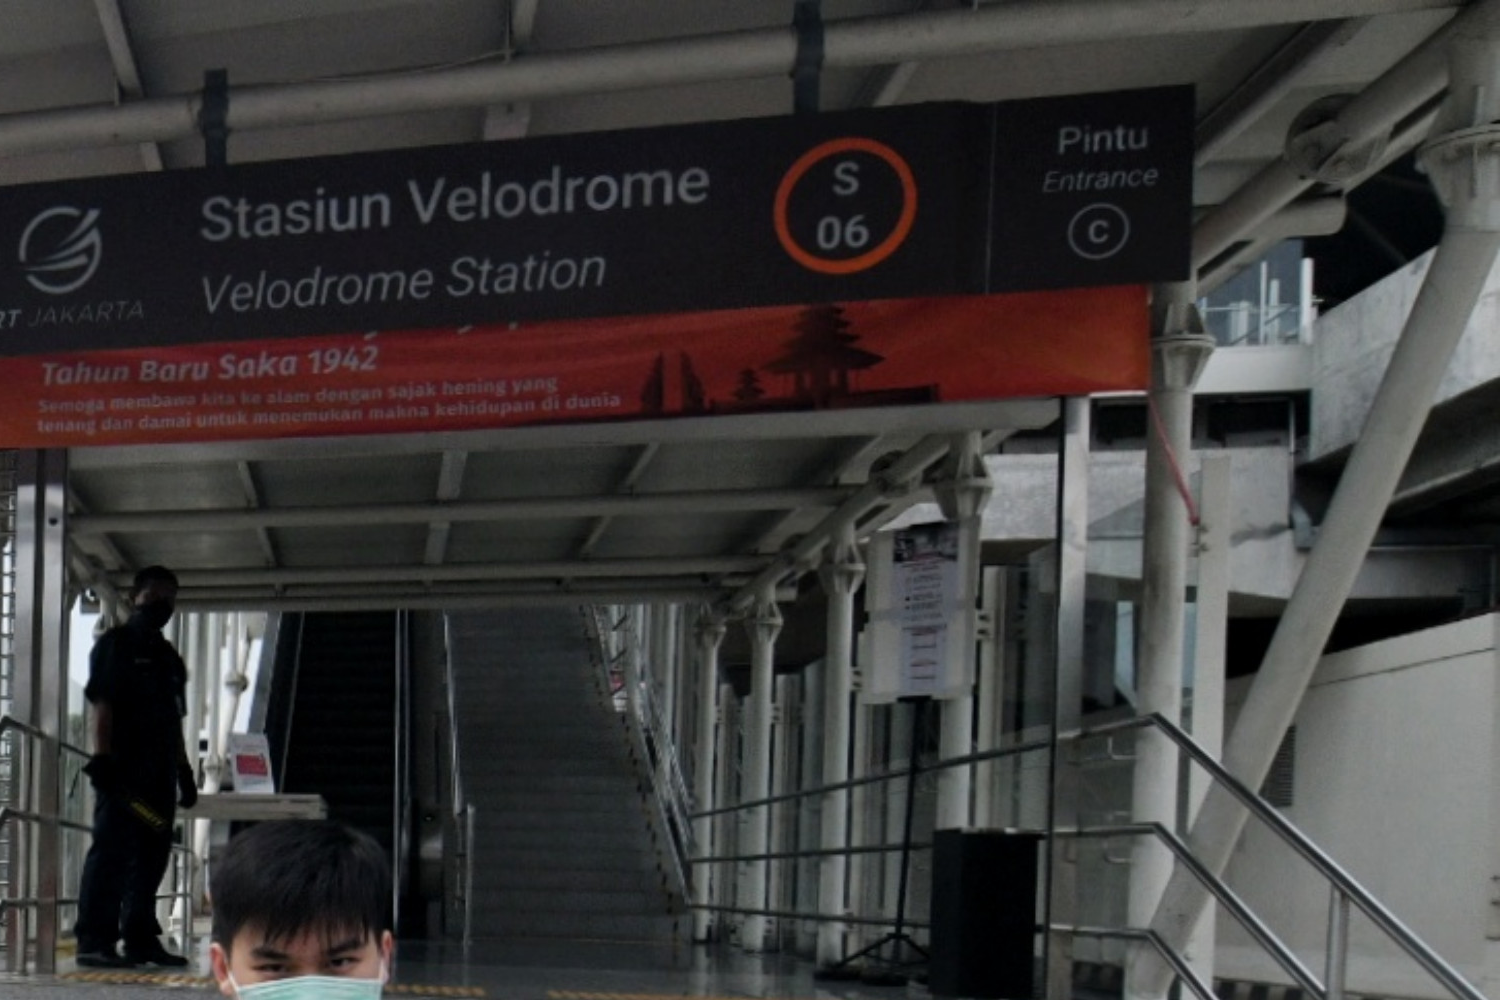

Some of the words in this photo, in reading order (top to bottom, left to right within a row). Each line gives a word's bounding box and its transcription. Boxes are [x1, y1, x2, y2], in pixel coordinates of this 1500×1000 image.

[1058, 125, 1148, 154] Pintu
[832, 160, 860, 196] S
[1043, 168, 1159, 193] Entrance
[200, 186, 391, 241] Stasiun
[407, 165, 710, 224] Velodrome
[816, 213, 870, 250] 06
[1088, 219, 1109, 244] C
[202, 265, 434, 314] Velodrome
[446, 250, 606, 296] Station
[28, 300, 145, 328] JAKARTA
[42, 360, 130, 386] Tahun
[139, 359, 210, 383] Baru
[218, 350, 298, 380] Saka
[306, 345, 379, 375] 1942
[37, 418, 96, 435] tenang
[101, 415, 133, 431] dan
[139, 411, 191, 429] damai
[196, 410, 247, 427] untuk
[252, 405, 363, 424] menemukan
[369, 402, 430, 420] makna
[435, 396, 536, 418] kehidupan
[542, 393, 560, 412] di
[566, 391, 621, 410] dunia
[38, 398, 105, 415] Semoga
[110, 393, 197, 410] membawa
[202, 392, 236, 406] kita
[241, 391, 261, 406] ke
[266, 389, 310, 405] alam
[315, 387, 382, 404] dengan
[388, 380, 436, 399] sajak
[442, 379, 507, 397] hening
[511, 376, 559, 395] yang
